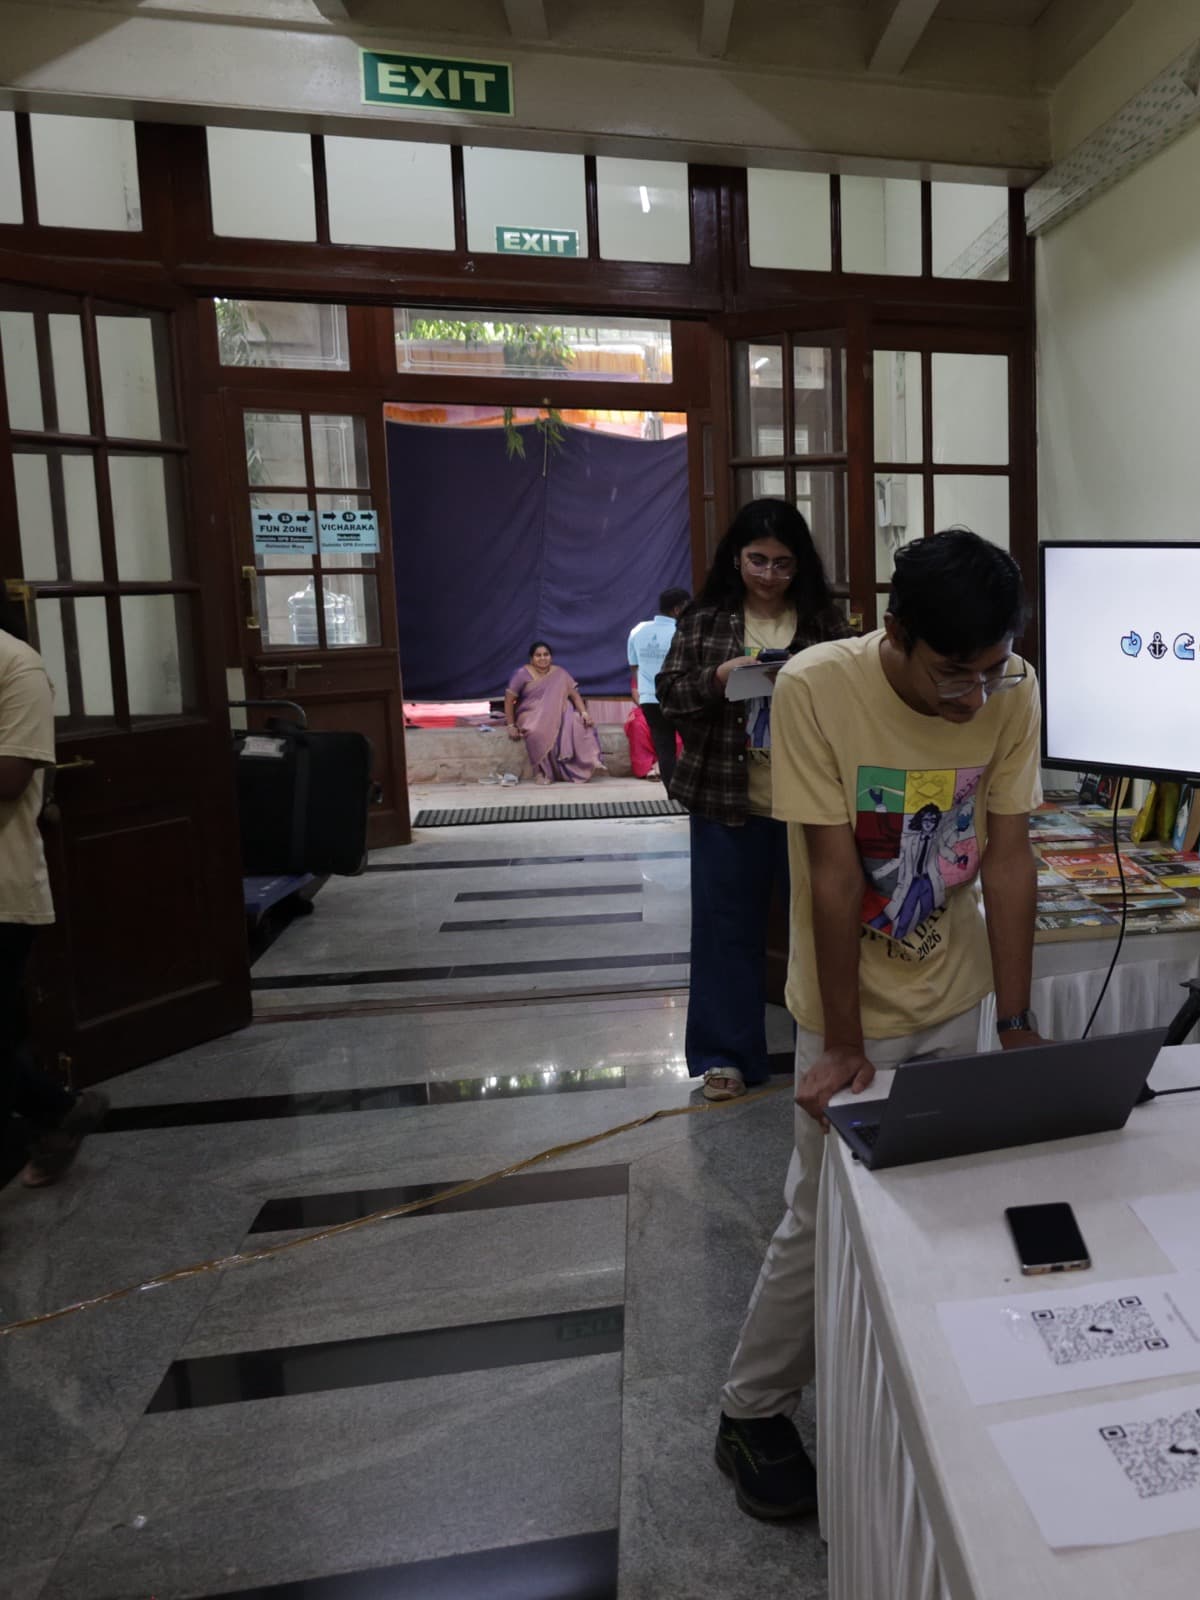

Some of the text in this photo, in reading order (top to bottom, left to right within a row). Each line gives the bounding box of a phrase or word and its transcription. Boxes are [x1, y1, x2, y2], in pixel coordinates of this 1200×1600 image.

[377, 61, 496, 103] EXIT
[503, 231, 569, 253] EXIT
[260, 525, 308, 533] FUN ZONE
[321, 523, 375, 531] VICHARAKA
[917, 929, 942, 961] 2026
